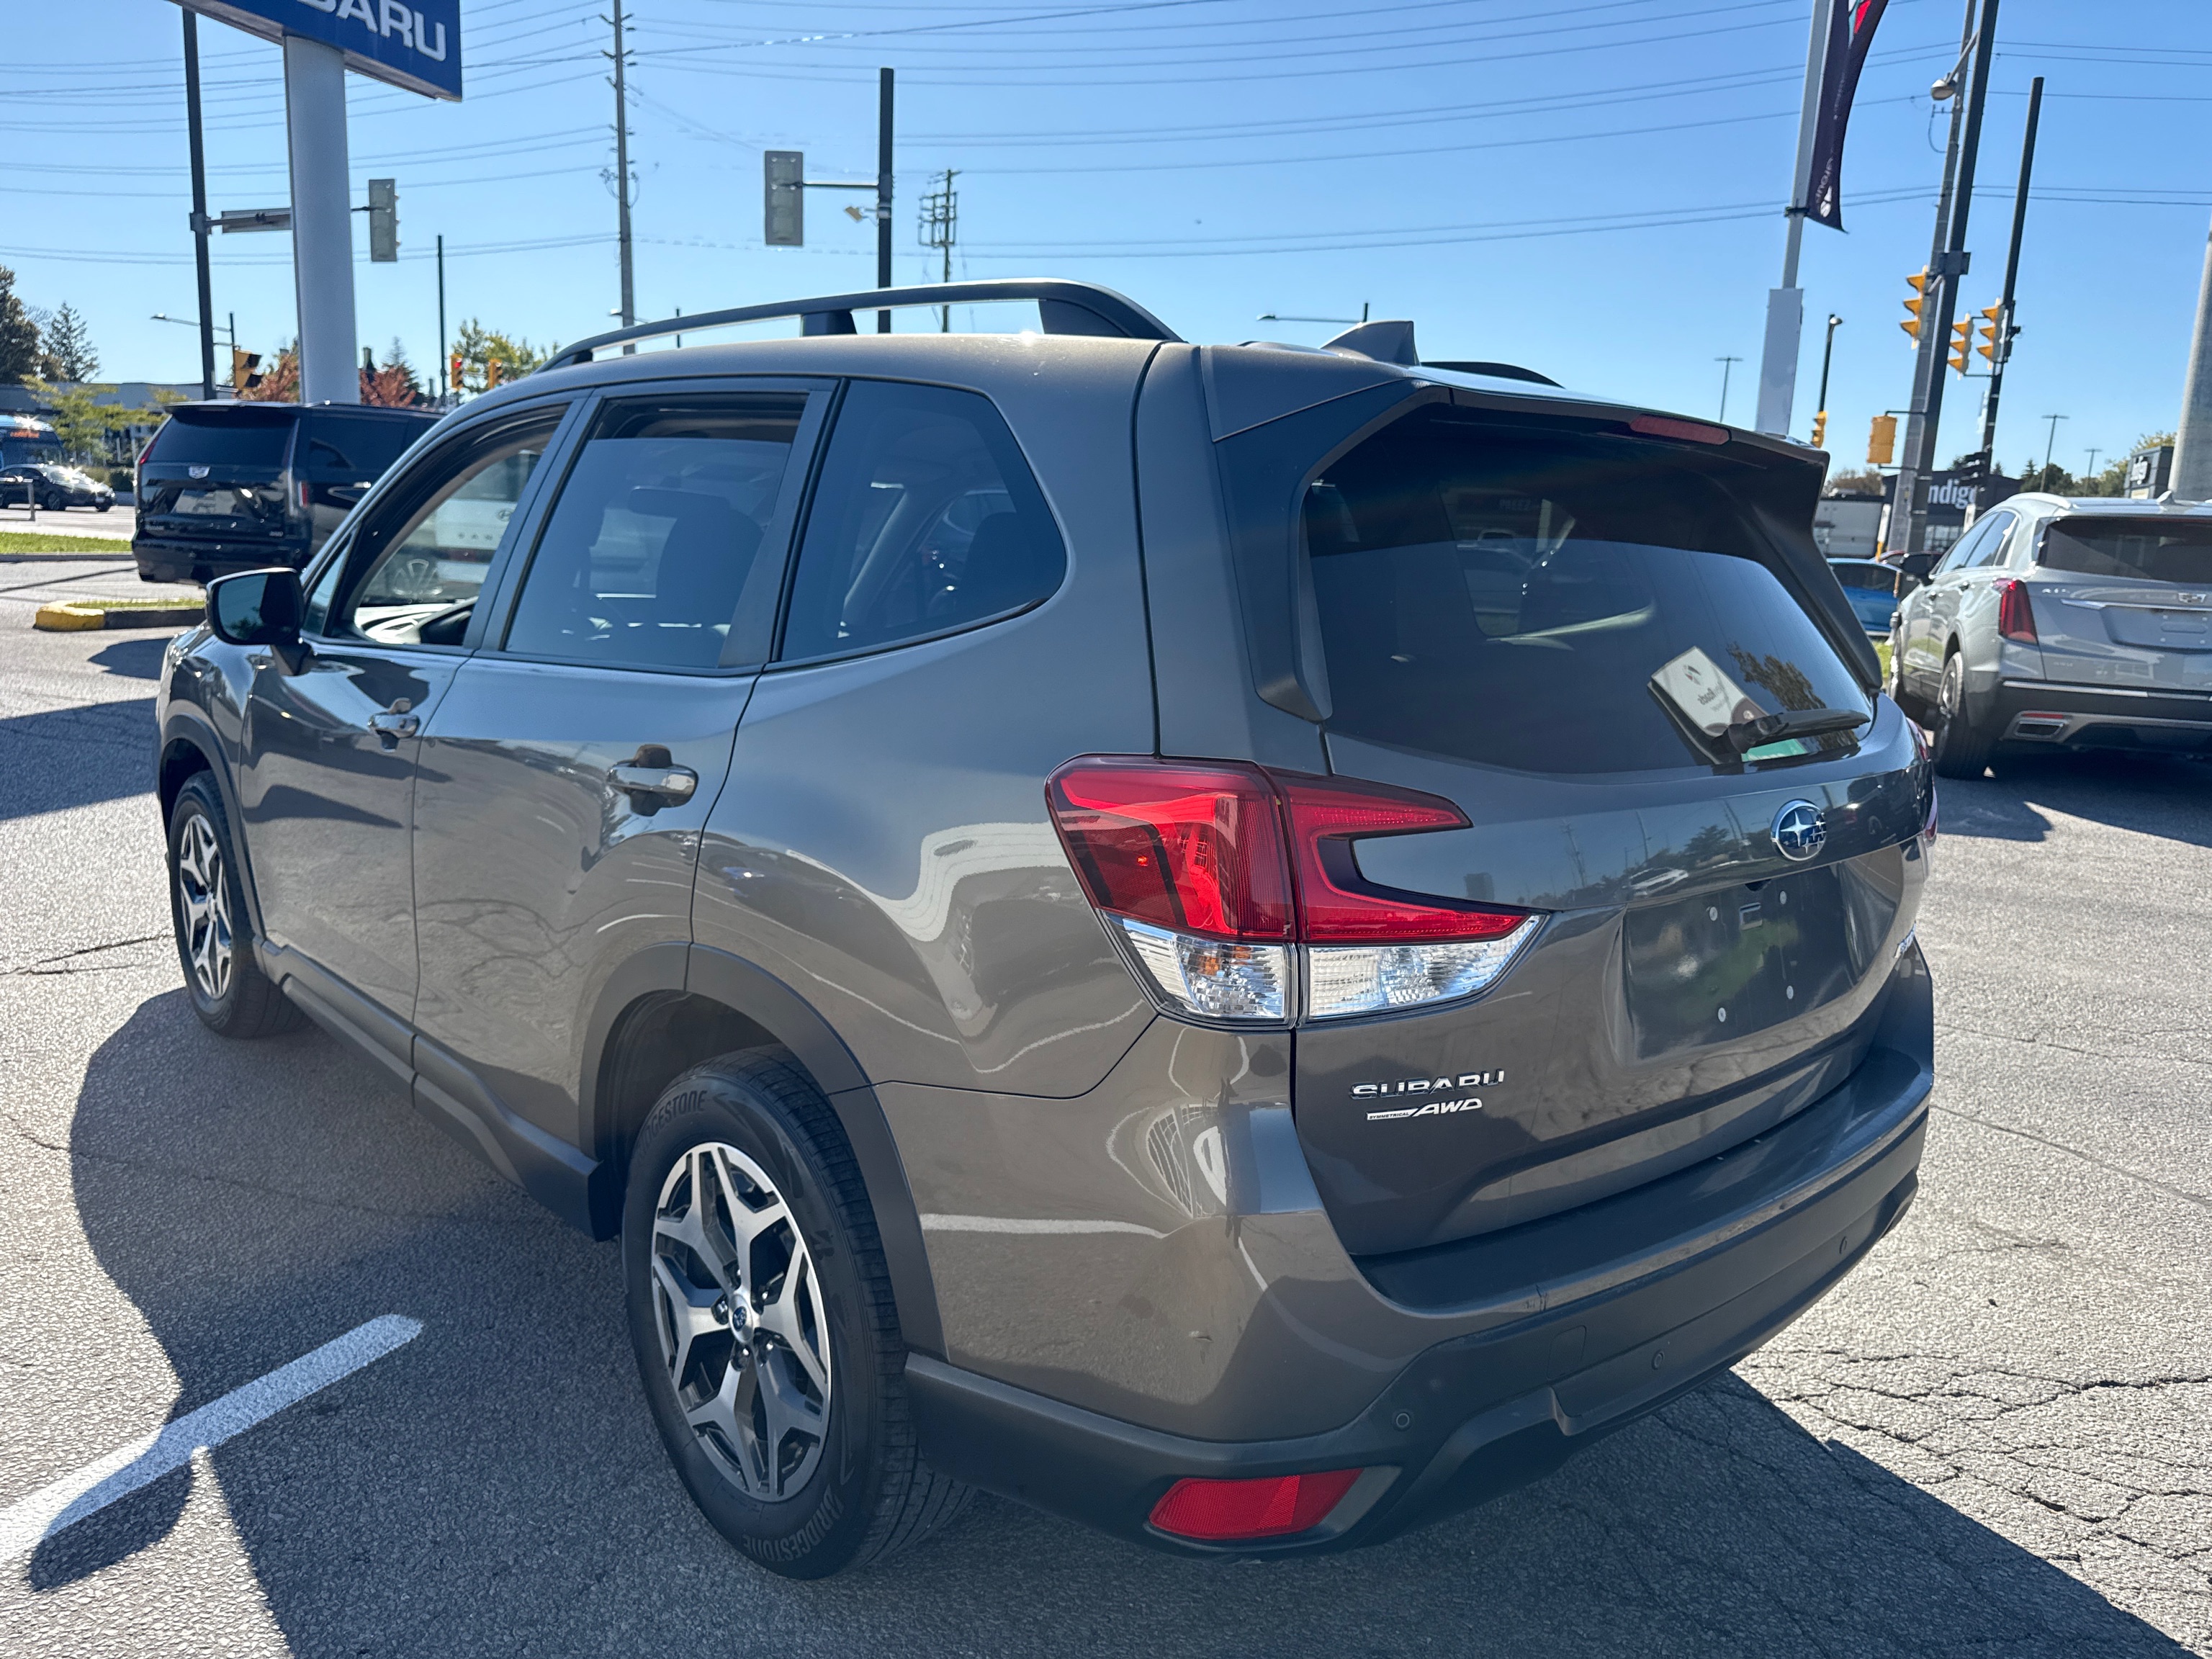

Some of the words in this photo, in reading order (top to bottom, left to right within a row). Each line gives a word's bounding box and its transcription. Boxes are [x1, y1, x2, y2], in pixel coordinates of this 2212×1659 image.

[1350, 1069, 1505, 1100] SUBARU
[1412, 1098, 1483, 1117] AWD
[742, 1483, 845, 1562] BRIDGESTONE
